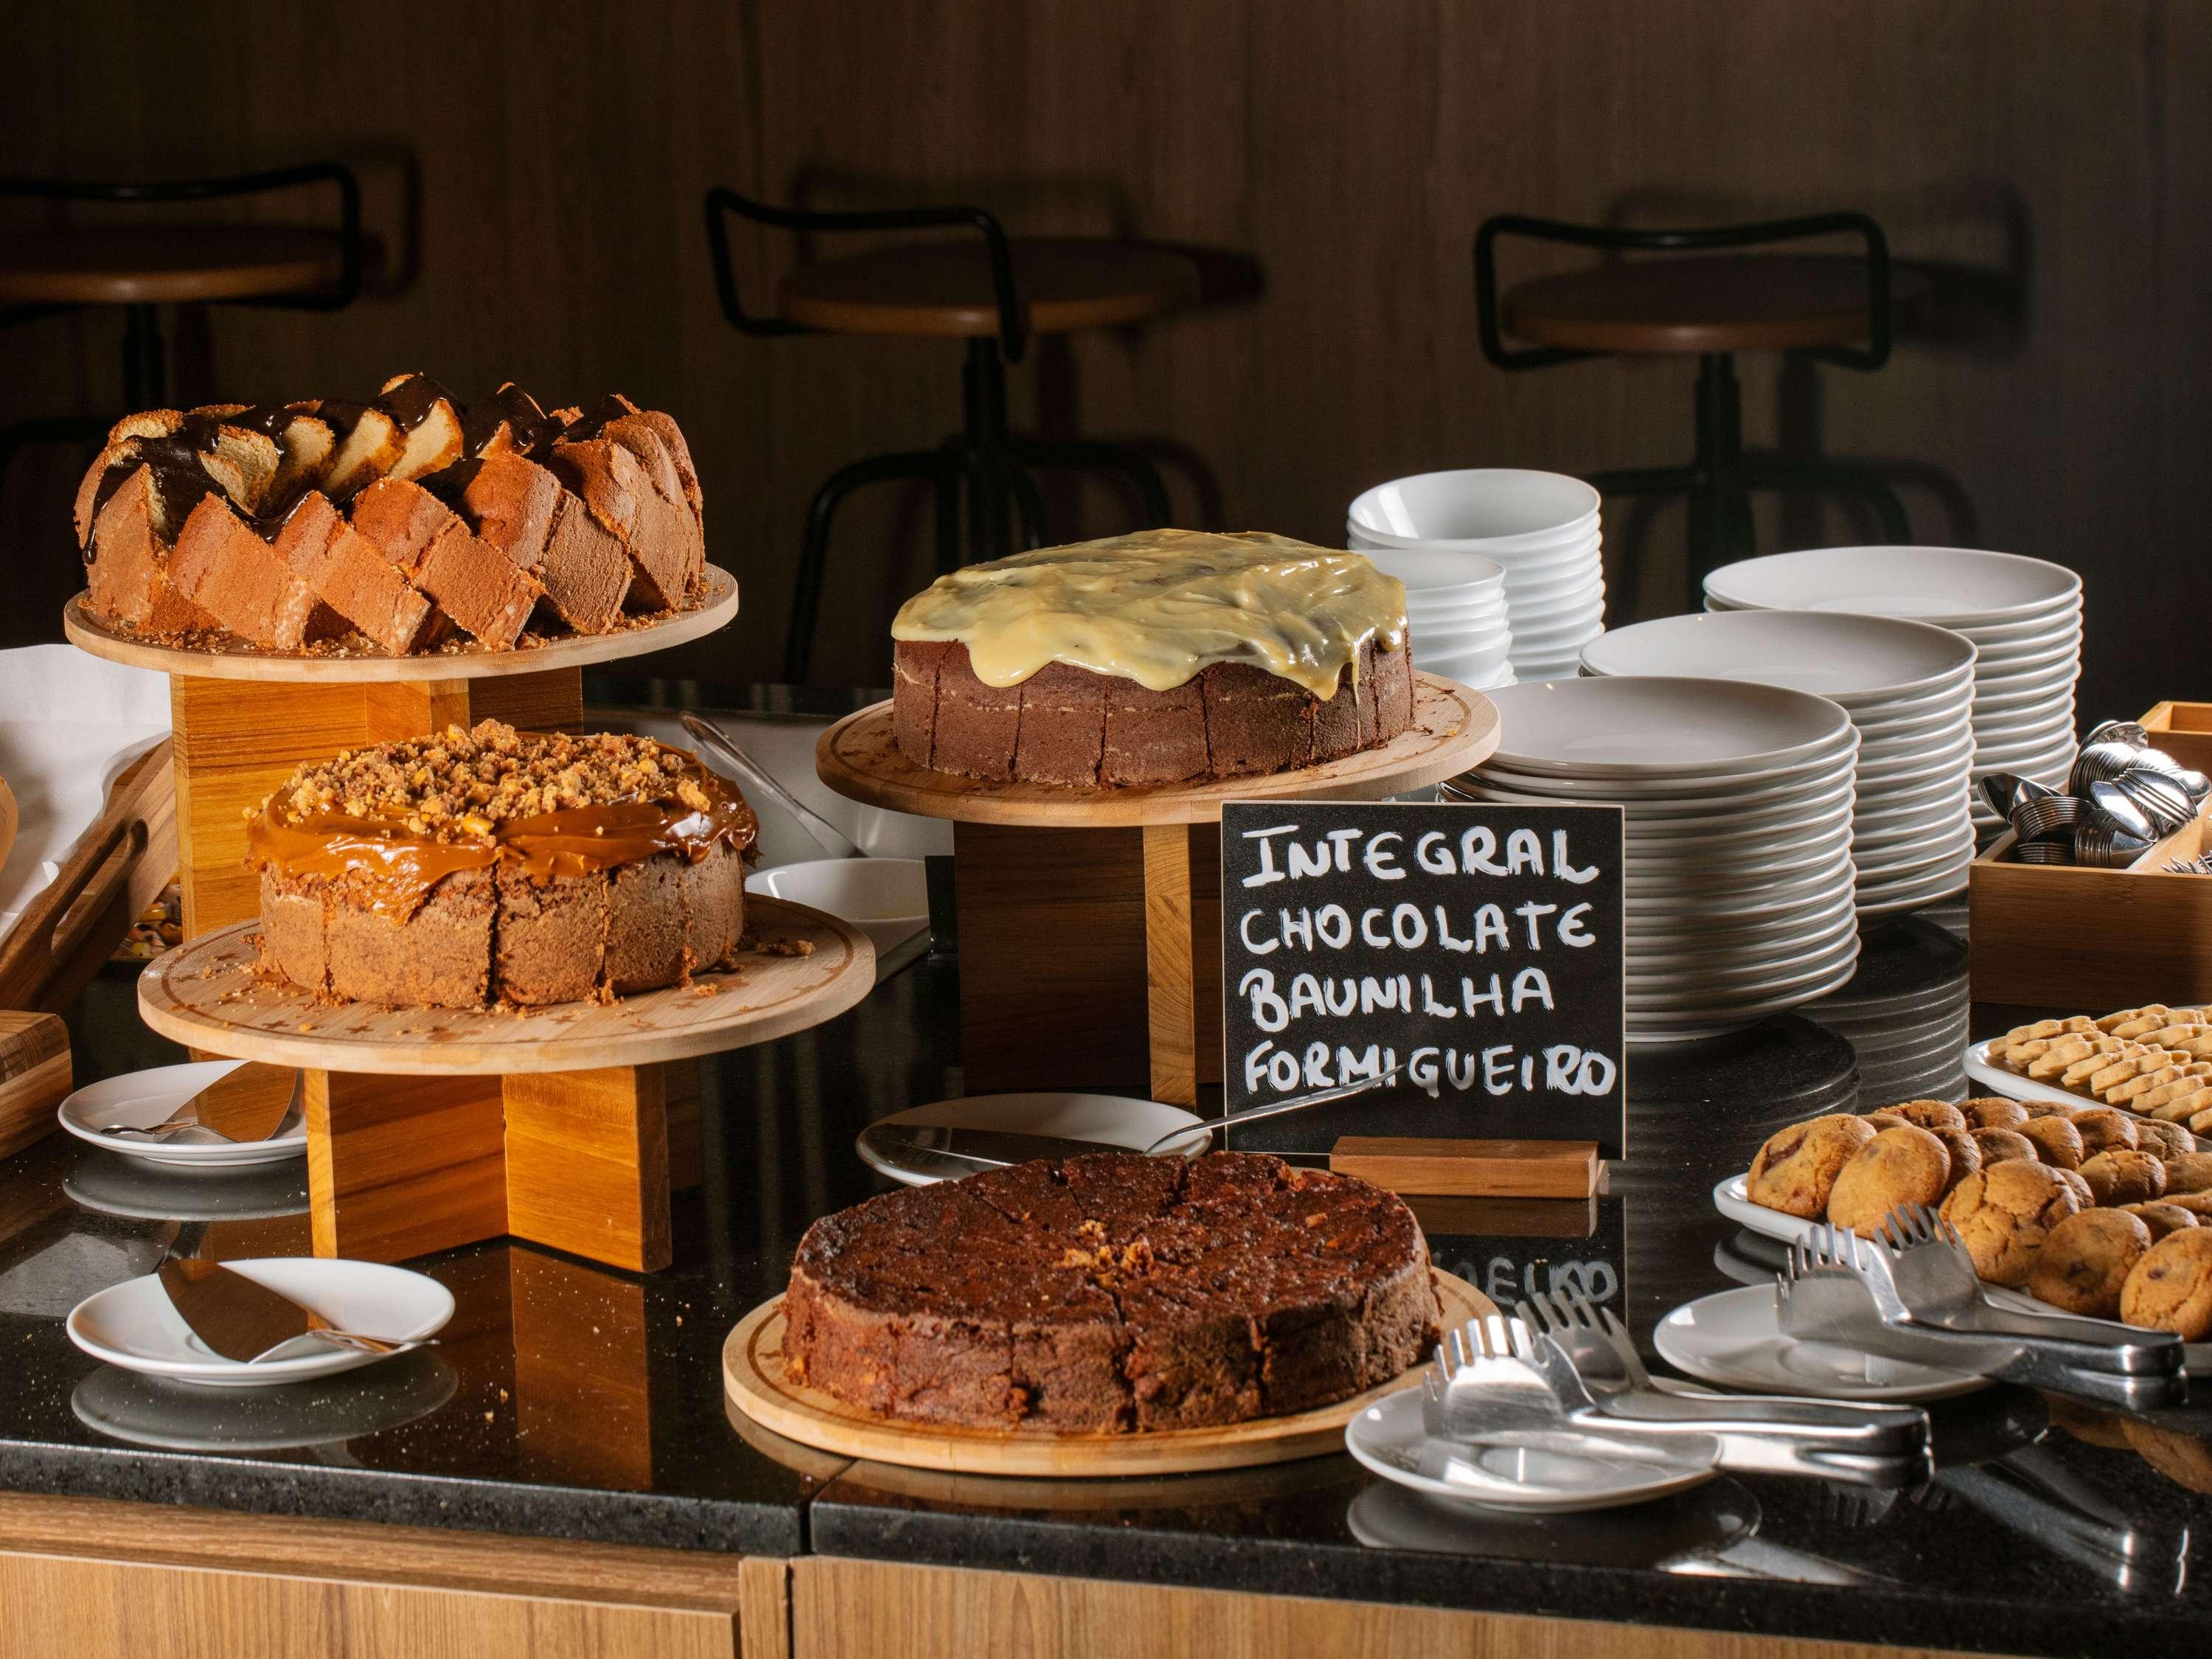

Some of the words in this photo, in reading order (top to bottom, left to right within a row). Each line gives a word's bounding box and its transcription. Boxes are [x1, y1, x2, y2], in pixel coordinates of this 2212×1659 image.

[1242, 825, 1600, 888] INTEGRAL
[1240, 900, 1596, 955] CHOCOLATE
[1239, 967, 1554, 1032] BAUNILHA
[1245, 1040, 1616, 1099] FORMIGUEIRO
